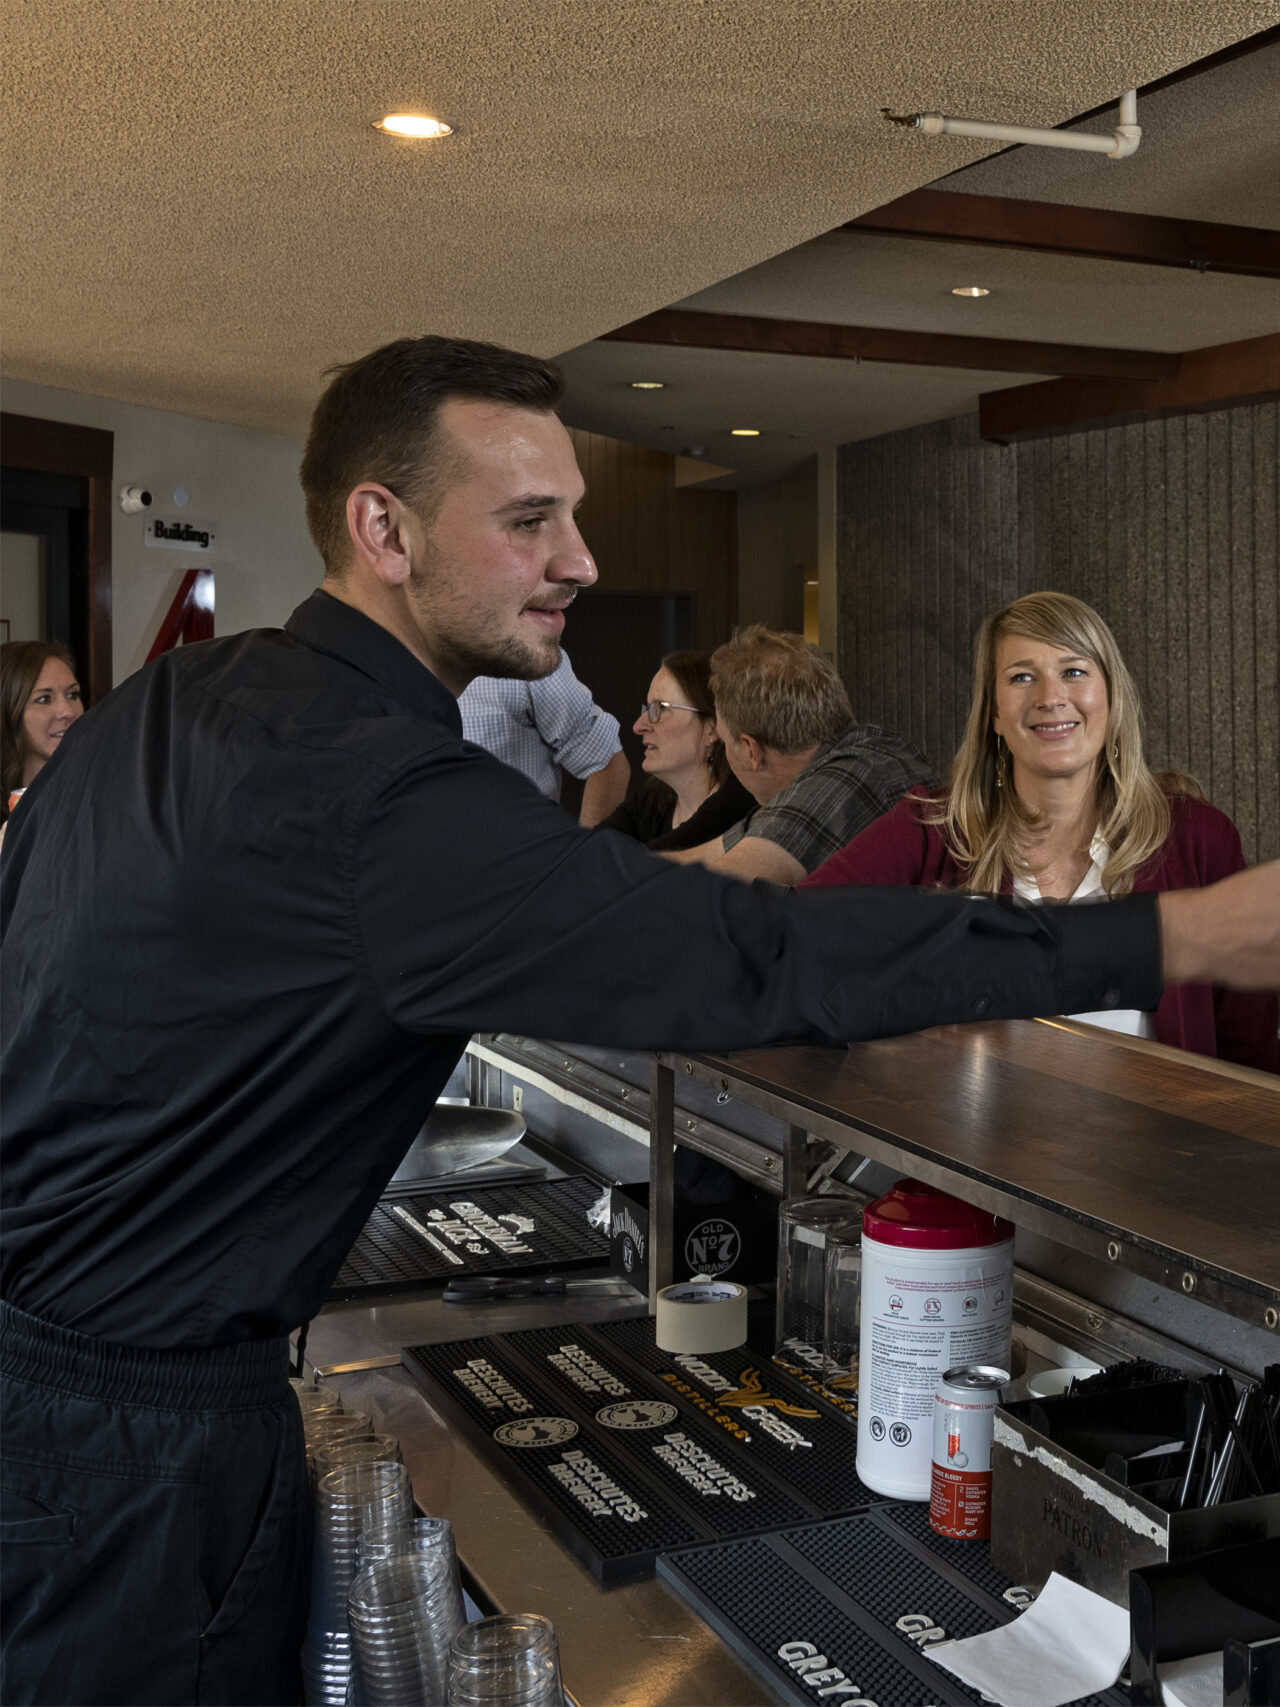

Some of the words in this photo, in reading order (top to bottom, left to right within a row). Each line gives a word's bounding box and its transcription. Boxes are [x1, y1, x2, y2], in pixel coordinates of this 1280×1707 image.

[154, 520, 210, 548] Building
[702, 1223, 724, 1235] OLD
[698, 1262, 730, 1274] BRAND
[453, 1368, 504, 1409] BREWERY
[466, 1358, 534, 1413] DESCHUTES
[547, 1353, 602, 1393] BREWERY
[559, 1344, 631, 1397] DESCHUTES
[741, 1404, 813, 1451] CREEK
[546, 1462, 613, 1517] BREWERY
[560, 1449, 649, 1523] DESCHUTES
[651, 1443, 721, 1496] BREWERY
[663, 1431, 756, 1502] DESCHUTES
[895, 1613, 957, 1652] GR
[777, 1640, 861, 1698] GREY
